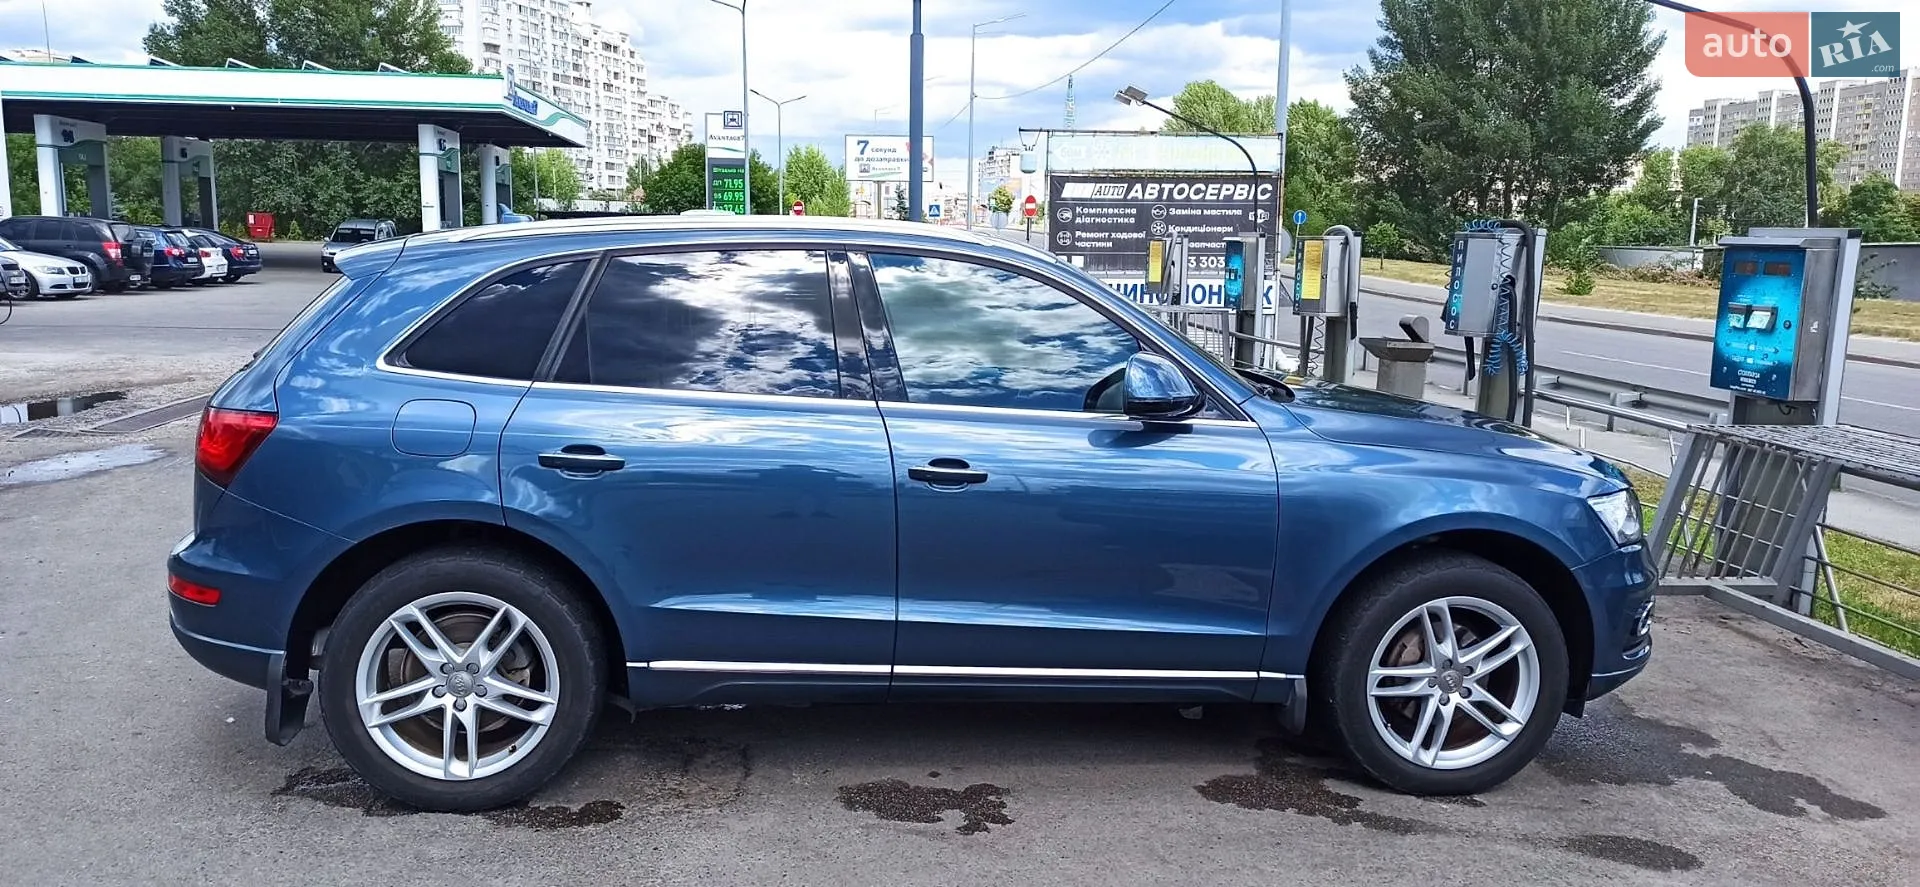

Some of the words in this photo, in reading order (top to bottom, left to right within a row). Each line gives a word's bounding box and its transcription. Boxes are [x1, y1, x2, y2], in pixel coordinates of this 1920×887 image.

[857, 140, 869, 155] 7
[724, 178, 743, 189] 71.95
[1094, 185, 1124, 196] AUTO
[1126, 183, 1273, 200] АВТОСЕРВІС
[723, 191, 744, 202] 69.95
[1075, 206, 1137, 214] Комплексна
[1203, 208, 1243, 216] мастила
[1075, 215, 1135, 224] діагностика
[1168, 224, 1234, 233] Кондиціонери
[1111, 231, 1146, 240] ходової
